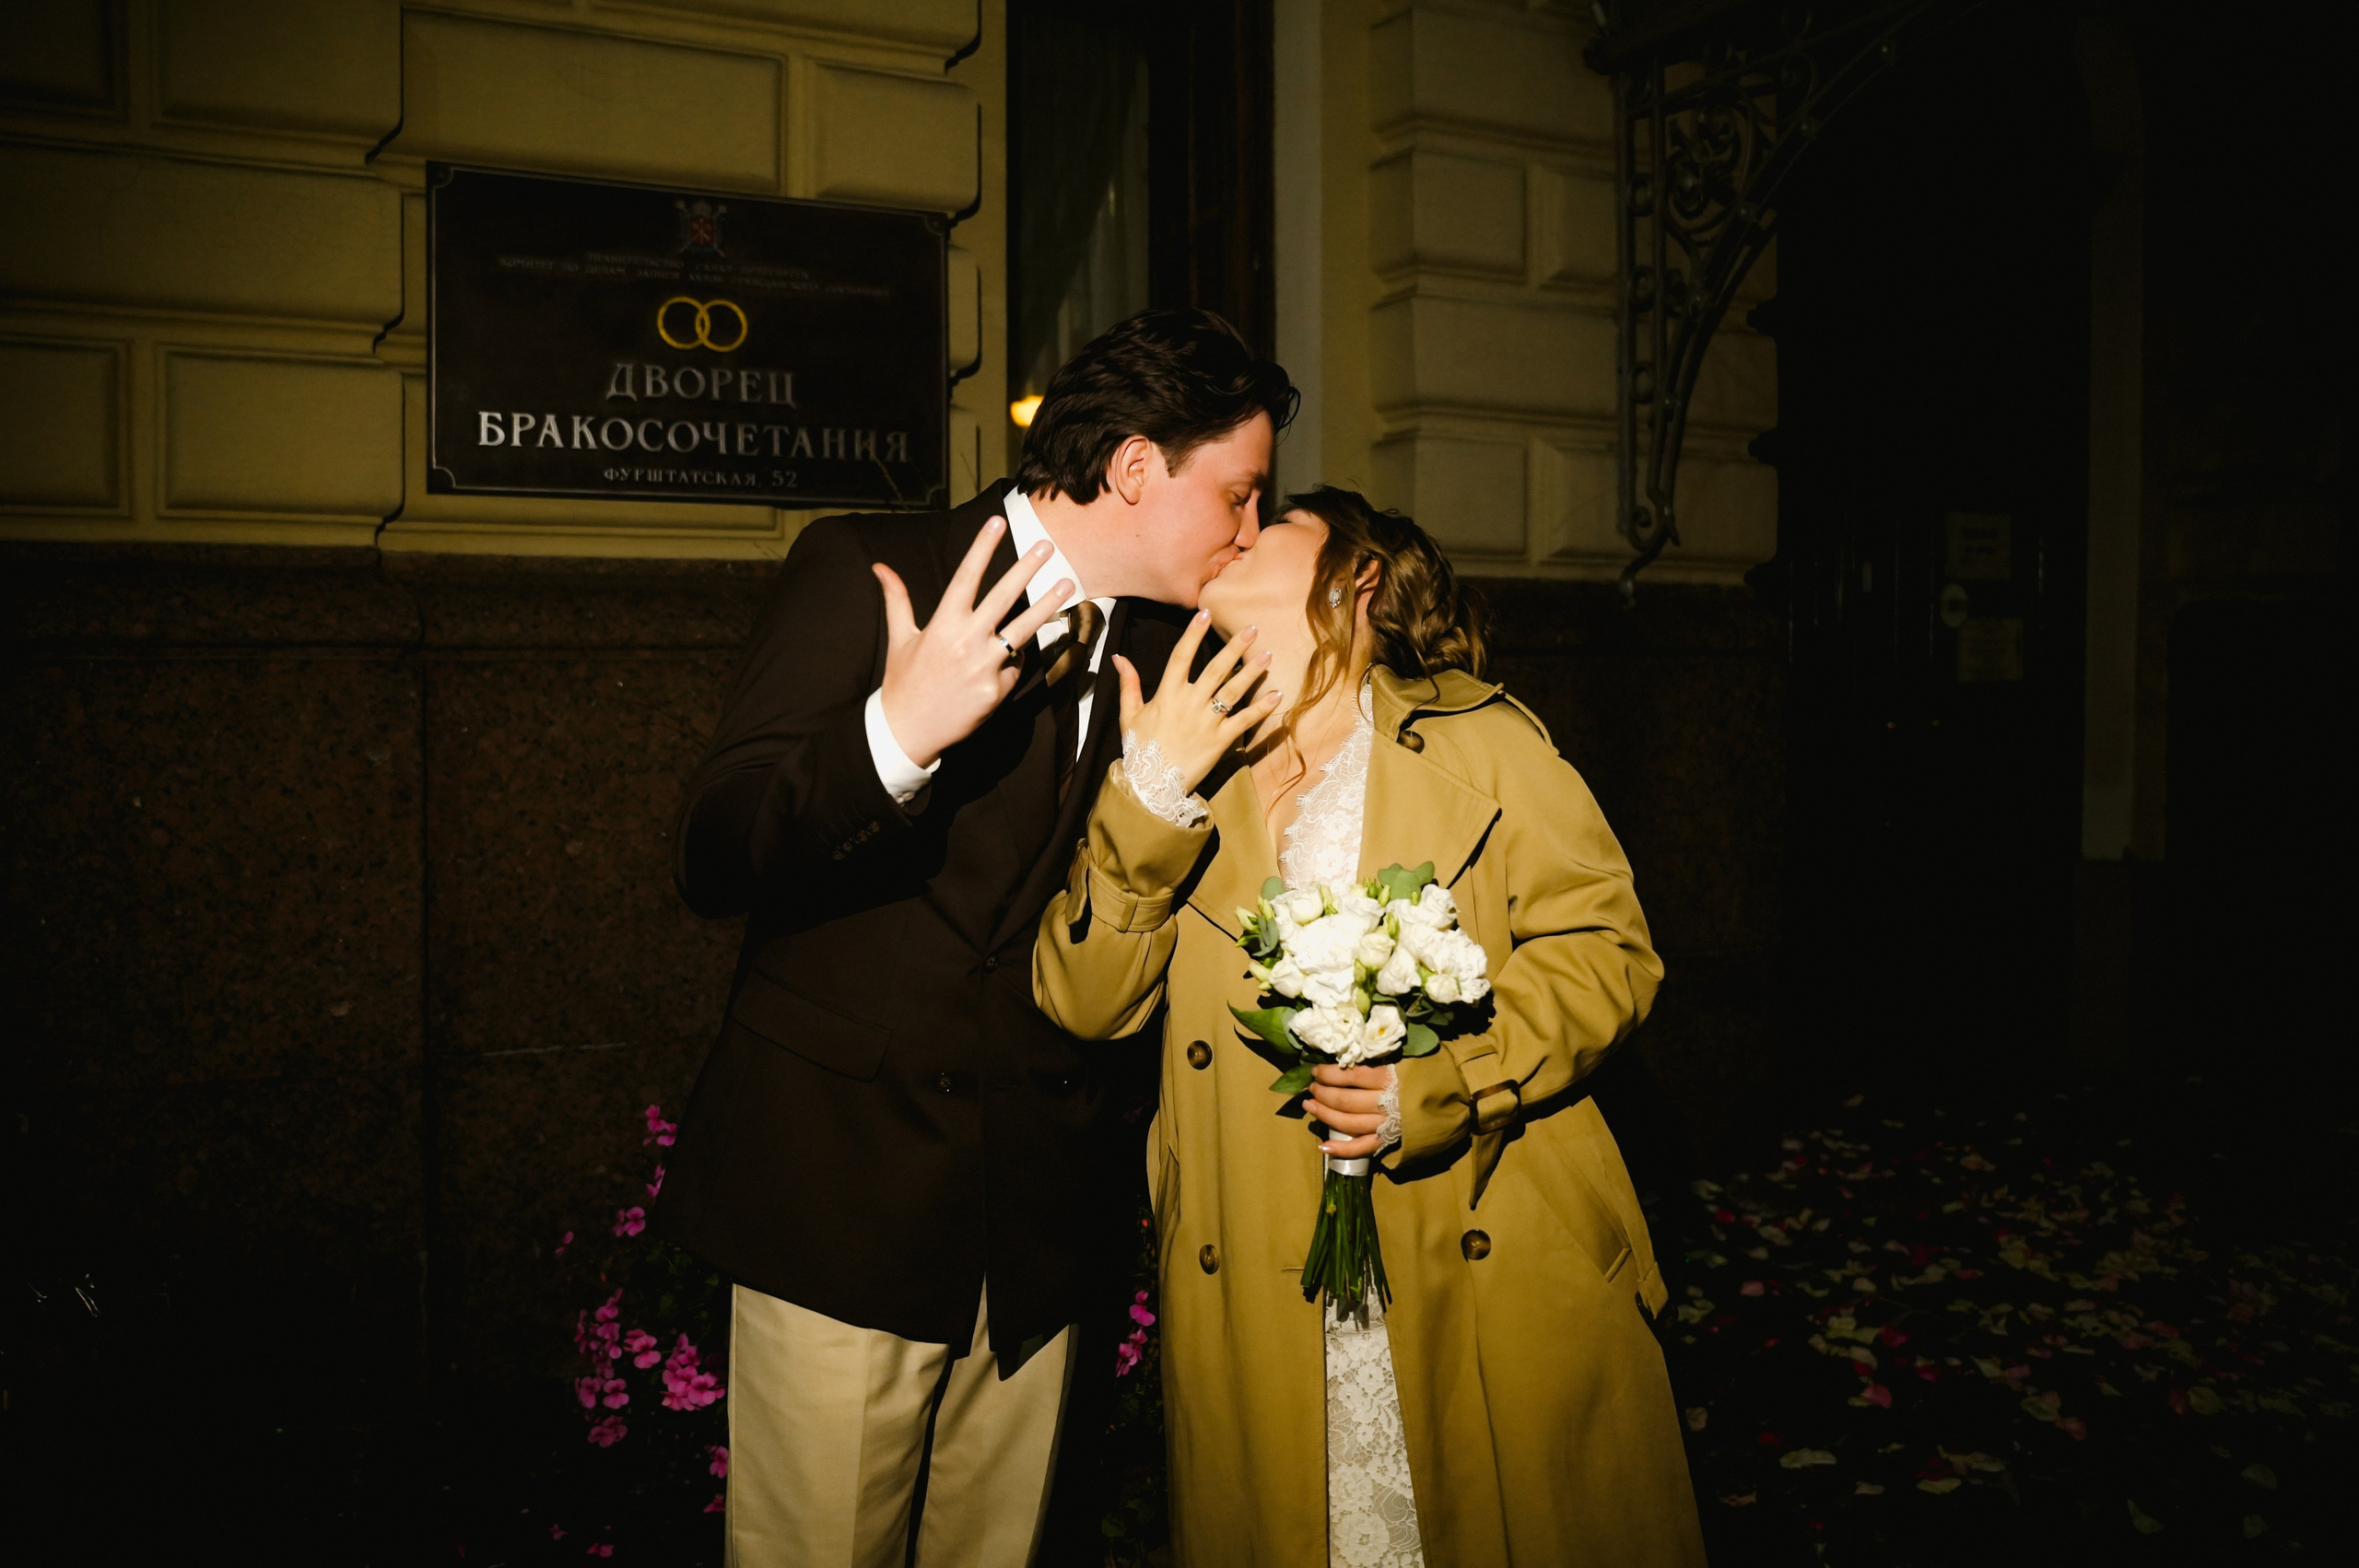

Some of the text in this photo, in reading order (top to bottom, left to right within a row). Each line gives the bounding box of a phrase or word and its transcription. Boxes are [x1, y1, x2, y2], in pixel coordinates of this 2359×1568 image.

[605, 362, 797, 410] ДВОРЕЦ
[477, 410, 910, 463] БРАКОСОЧЕТАНИЯ
[771, 470, 799, 488] 52
